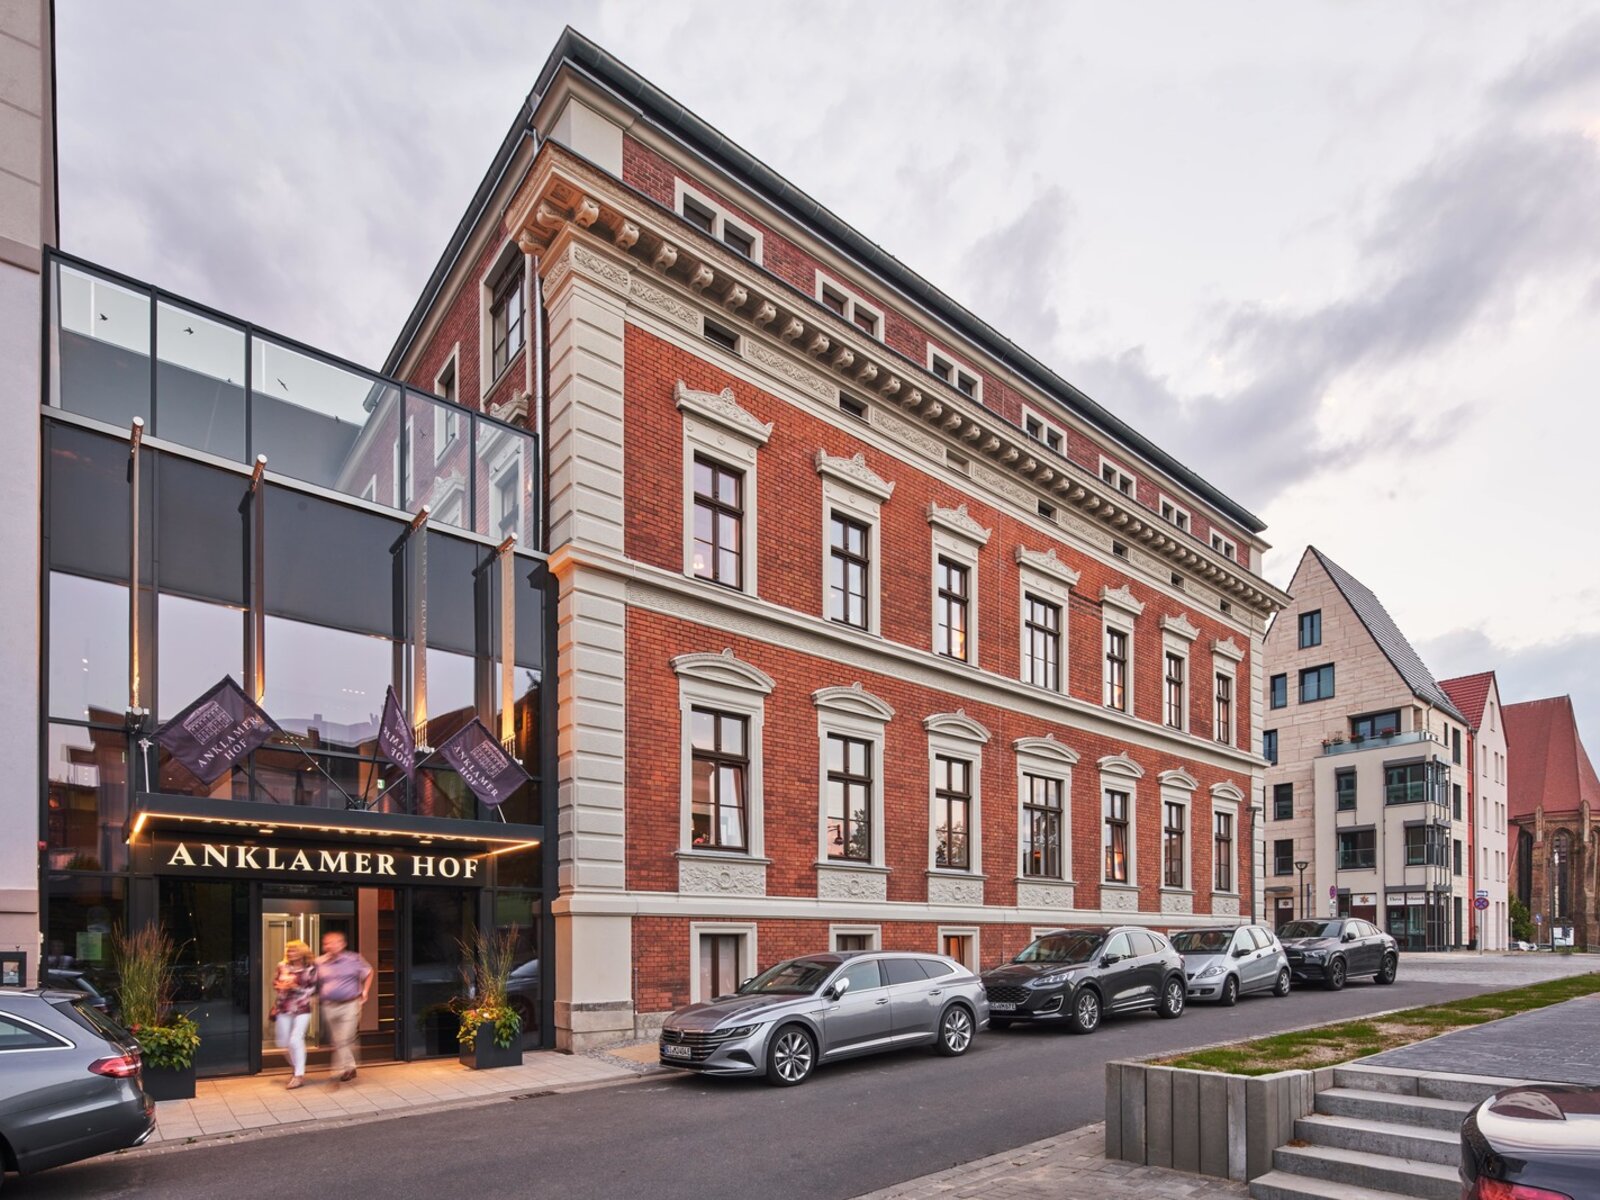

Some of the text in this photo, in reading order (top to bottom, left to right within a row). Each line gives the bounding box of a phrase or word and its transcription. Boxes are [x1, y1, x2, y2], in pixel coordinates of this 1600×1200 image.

[198, 715, 260, 768] ANKLAMER
[224, 738, 247, 761] HOF
[453, 745, 498, 797] ANKLAMER
[459, 767, 479, 786] HOF
[167, 842, 479, 879] ANKLAMER HOF
